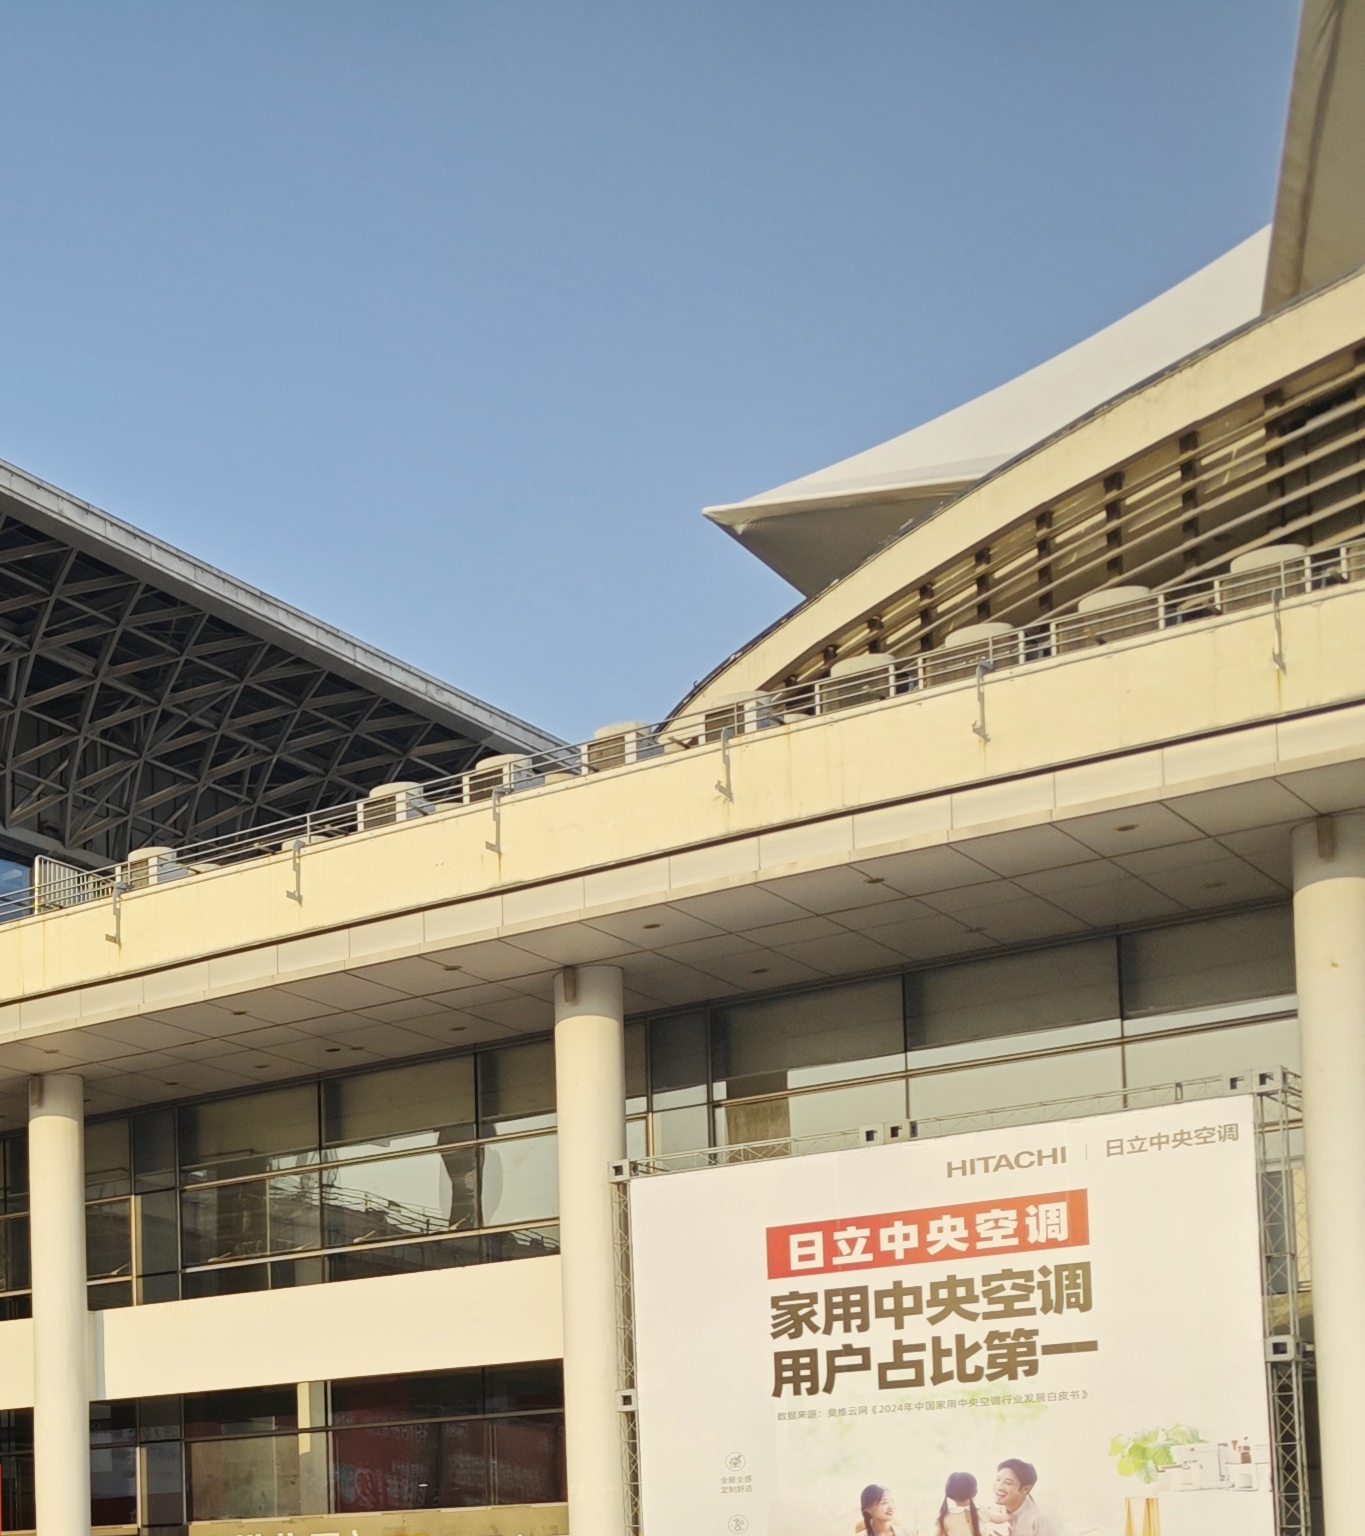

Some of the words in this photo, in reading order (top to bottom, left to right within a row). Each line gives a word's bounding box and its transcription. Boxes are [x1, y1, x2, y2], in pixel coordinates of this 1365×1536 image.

[945, 1145, 1068, 1180] HITACHI
[1105, 1122, 1241, 1159] 日立中央空调
[787, 1199, 1071, 1272] 日立中央空调
[769, 1261, 1095, 1341] 家用中央空调
[771, 1329, 1099, 1398] 用户占比第一
